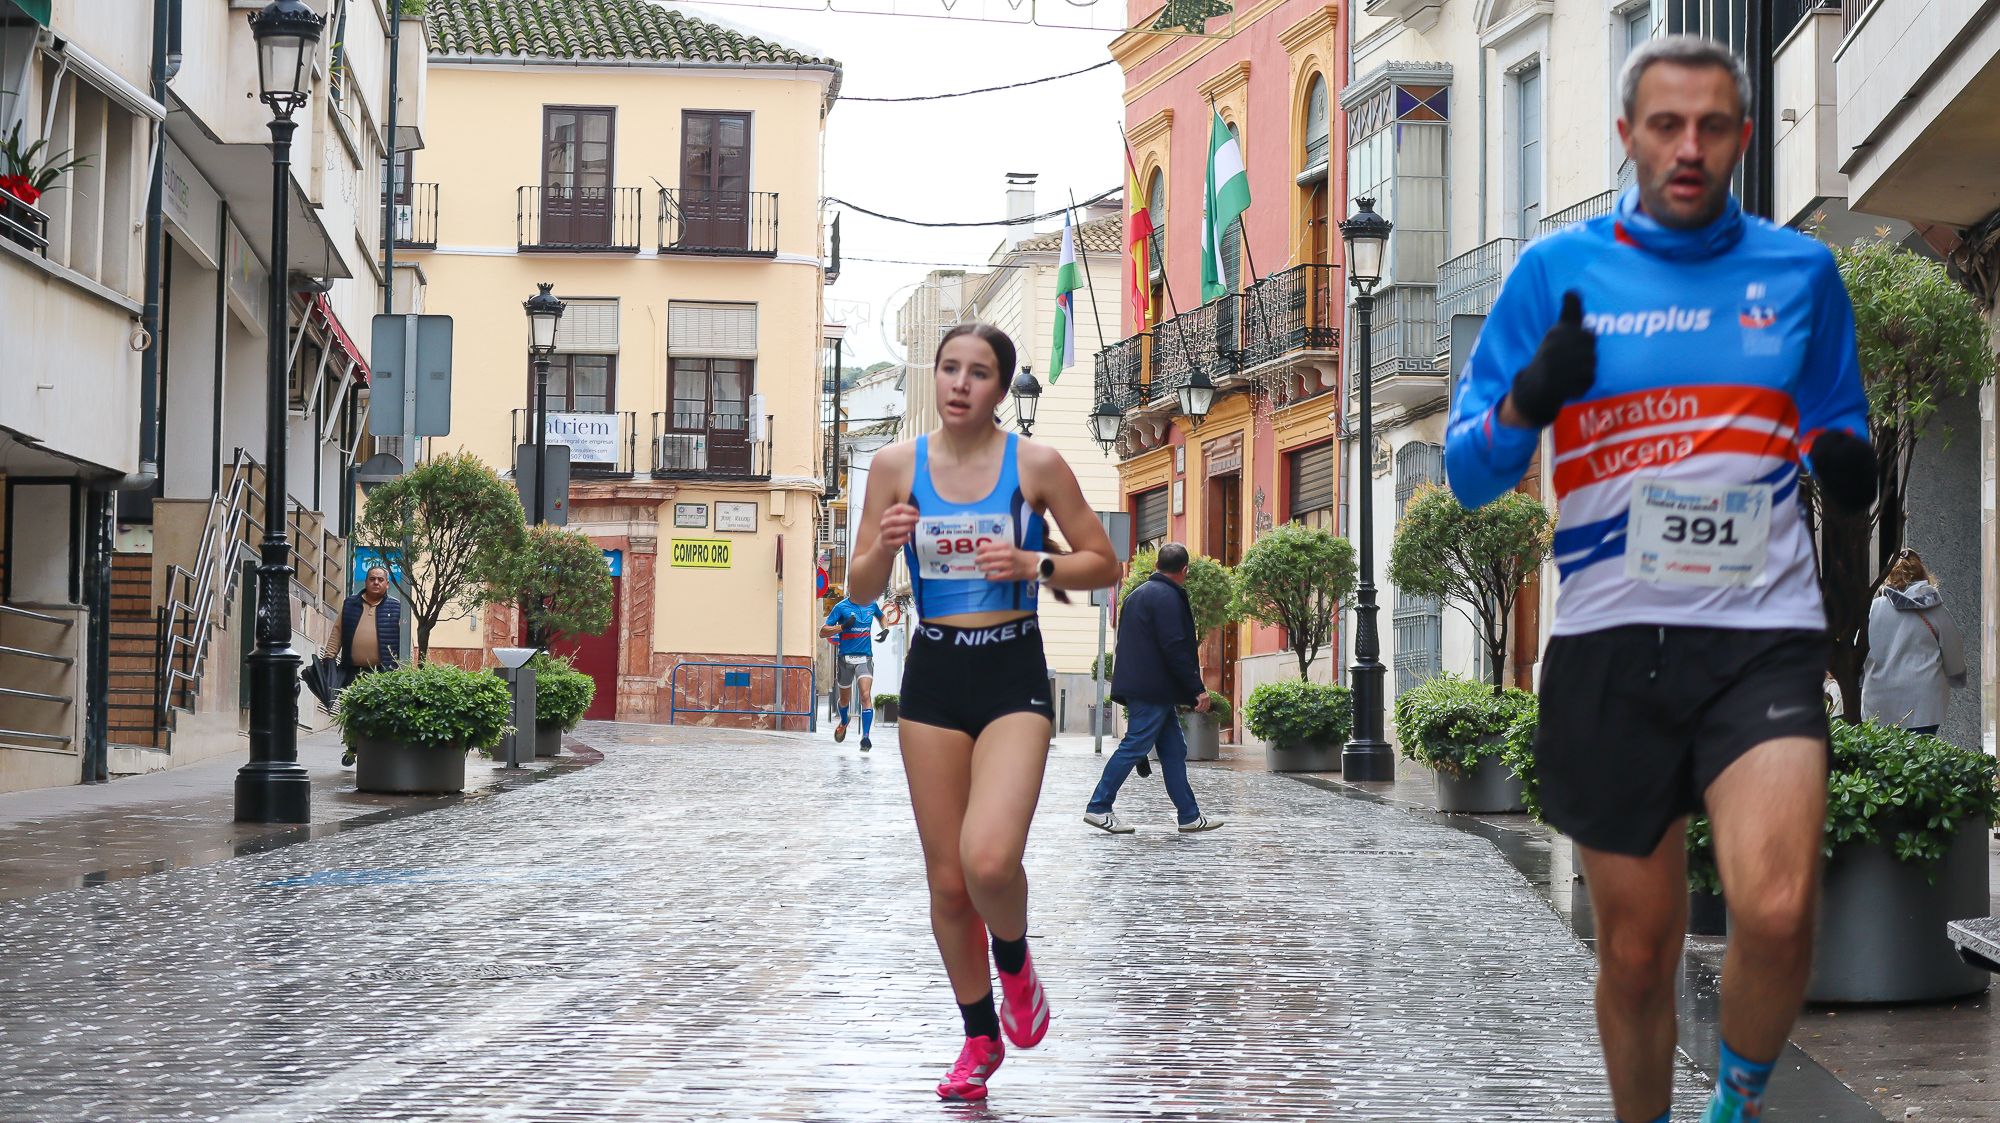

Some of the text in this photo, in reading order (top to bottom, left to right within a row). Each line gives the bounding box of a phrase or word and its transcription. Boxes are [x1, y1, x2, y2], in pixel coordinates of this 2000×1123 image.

[1582, 304, 1712, 338] enerplus
[1579, 389, 1699, 441] Maratón
[1588, 435, 1693, 479] Lucena
[1661, 515, 1739, 546] 391
[674, 543, 729, 563] COMPRO ORO
[955, 624, 1017, 646] NIKE
